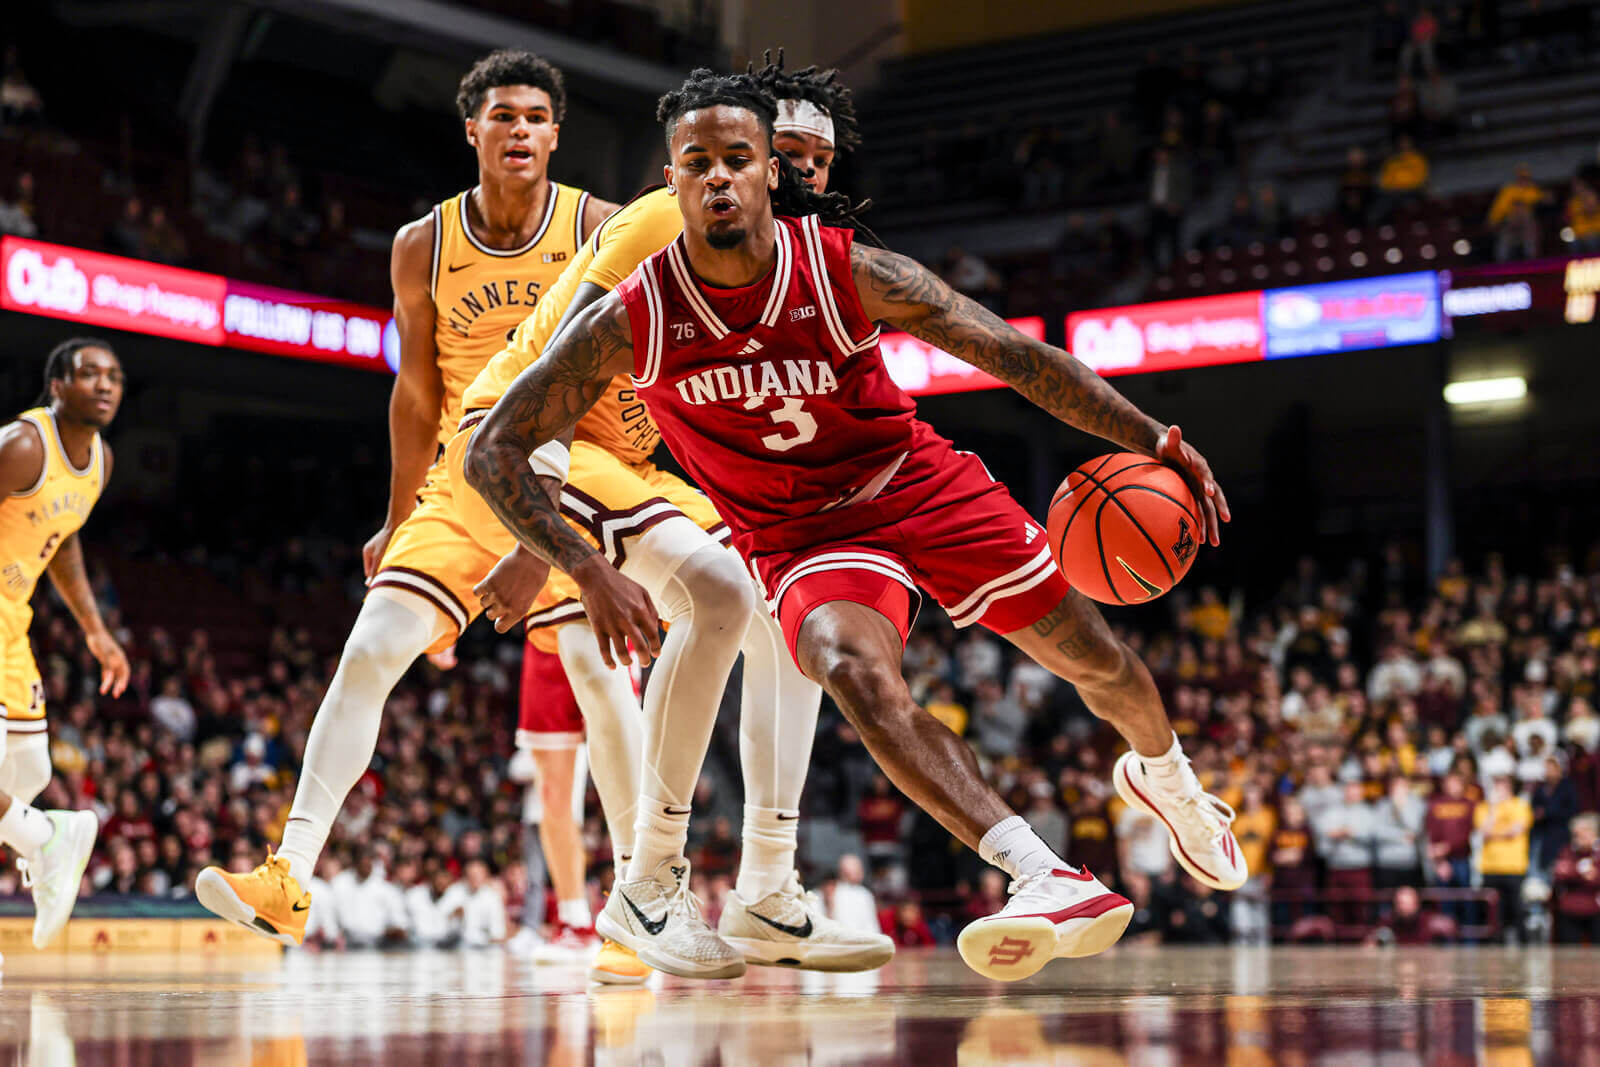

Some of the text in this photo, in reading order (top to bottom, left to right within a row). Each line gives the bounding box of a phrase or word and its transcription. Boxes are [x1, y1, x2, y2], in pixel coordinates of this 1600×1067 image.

[224, 294, 381, 358] FOLLOW US ON
[675, 359, 839, 406] INDIANA
[742, 396, 819, 452] 3
